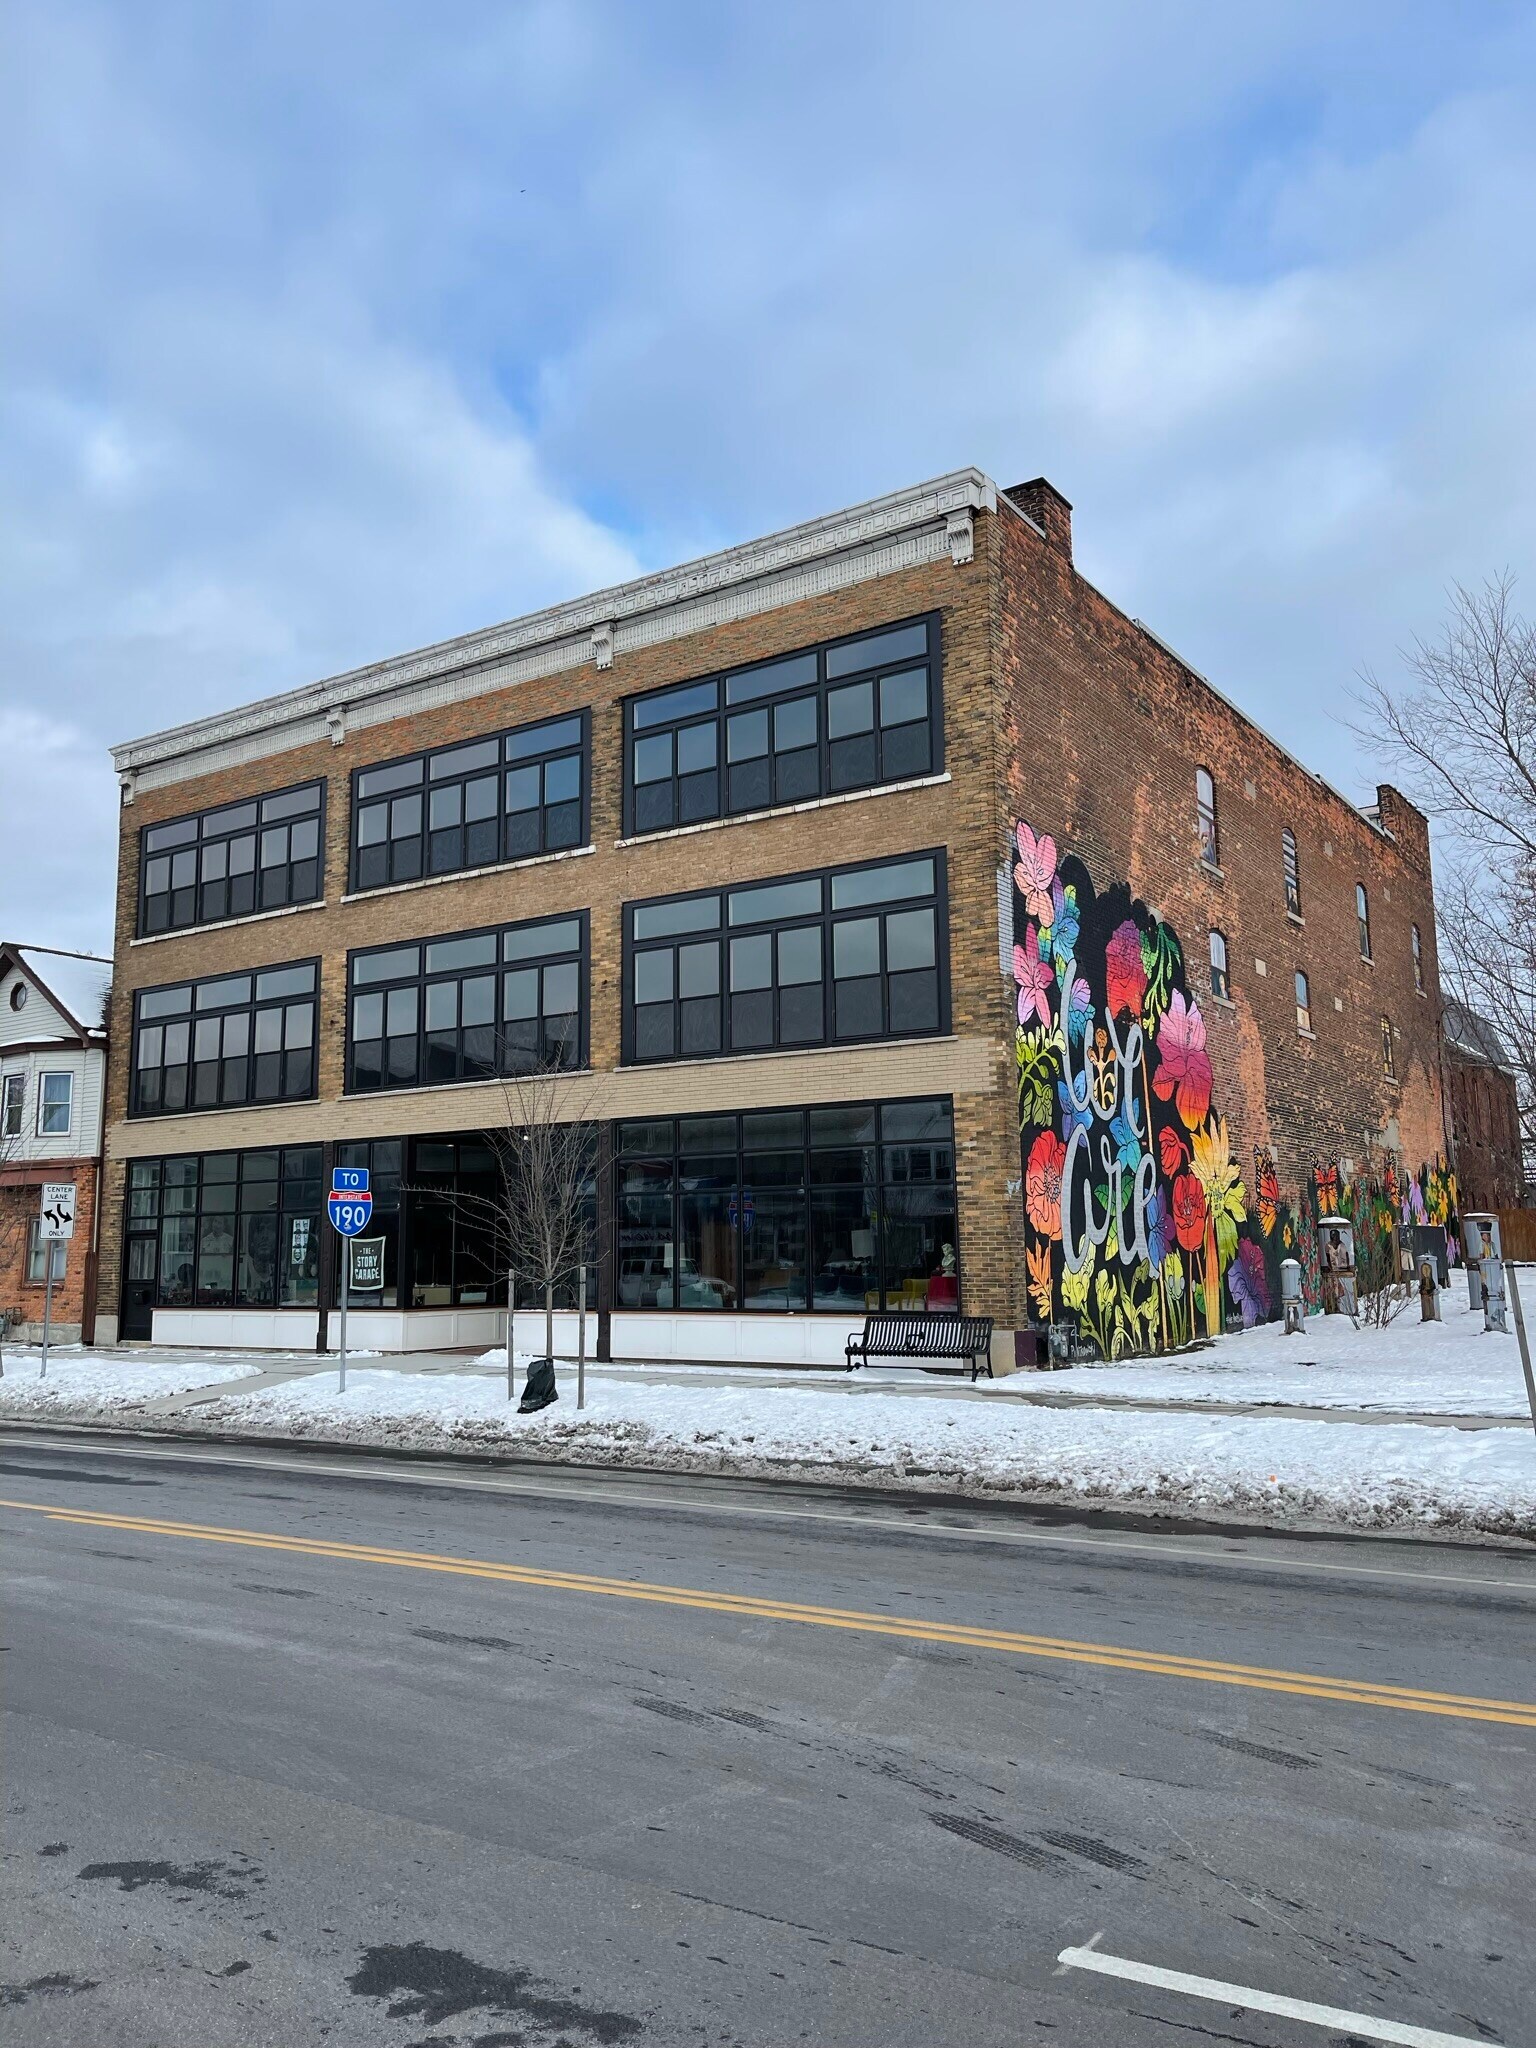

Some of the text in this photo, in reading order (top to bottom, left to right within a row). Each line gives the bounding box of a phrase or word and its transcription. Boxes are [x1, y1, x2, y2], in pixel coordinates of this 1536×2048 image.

[1060, 958, 1145, 1139] We
[342, 1172, 359, 1186] TO
[335, 1206, 365, 1227] 190
[356, 1255, 378, 1268] STORY
